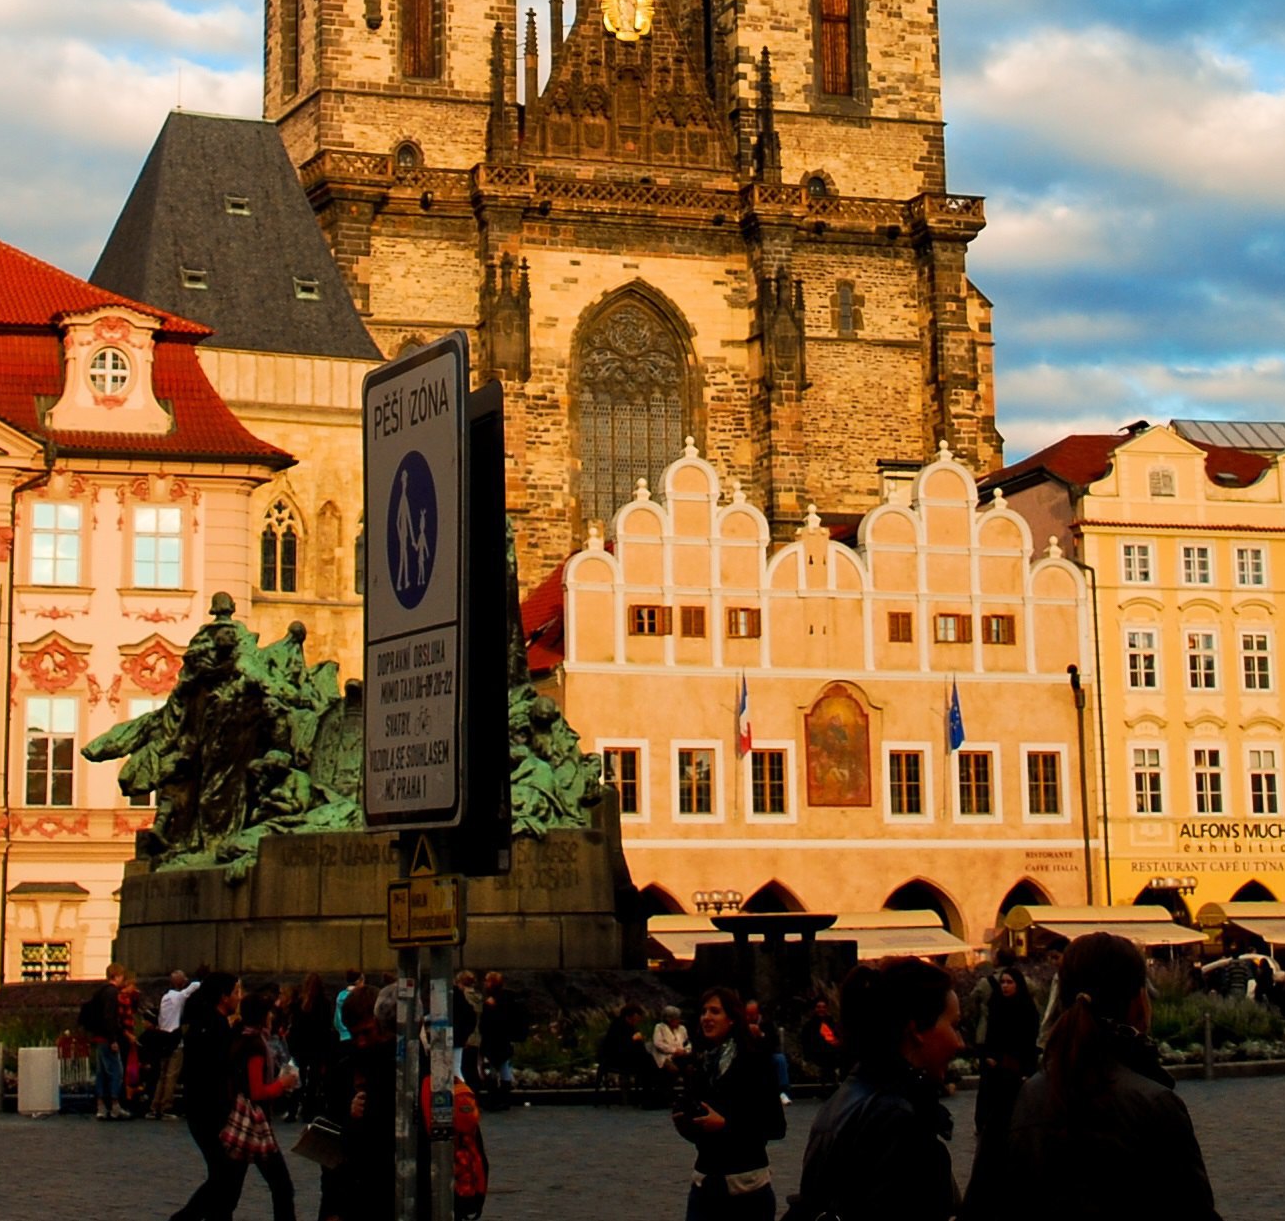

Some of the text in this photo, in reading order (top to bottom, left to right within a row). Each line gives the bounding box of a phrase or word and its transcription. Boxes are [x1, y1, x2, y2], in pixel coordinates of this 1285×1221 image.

[374, 377, 449, 440] PĚŠÍ ZÓNA
[1179, 823, 1240, 839] ALFONS
[1131, 862, 1206, 872] RESTAURANT
[1209, 861, 1240, 872] CAFÉ
